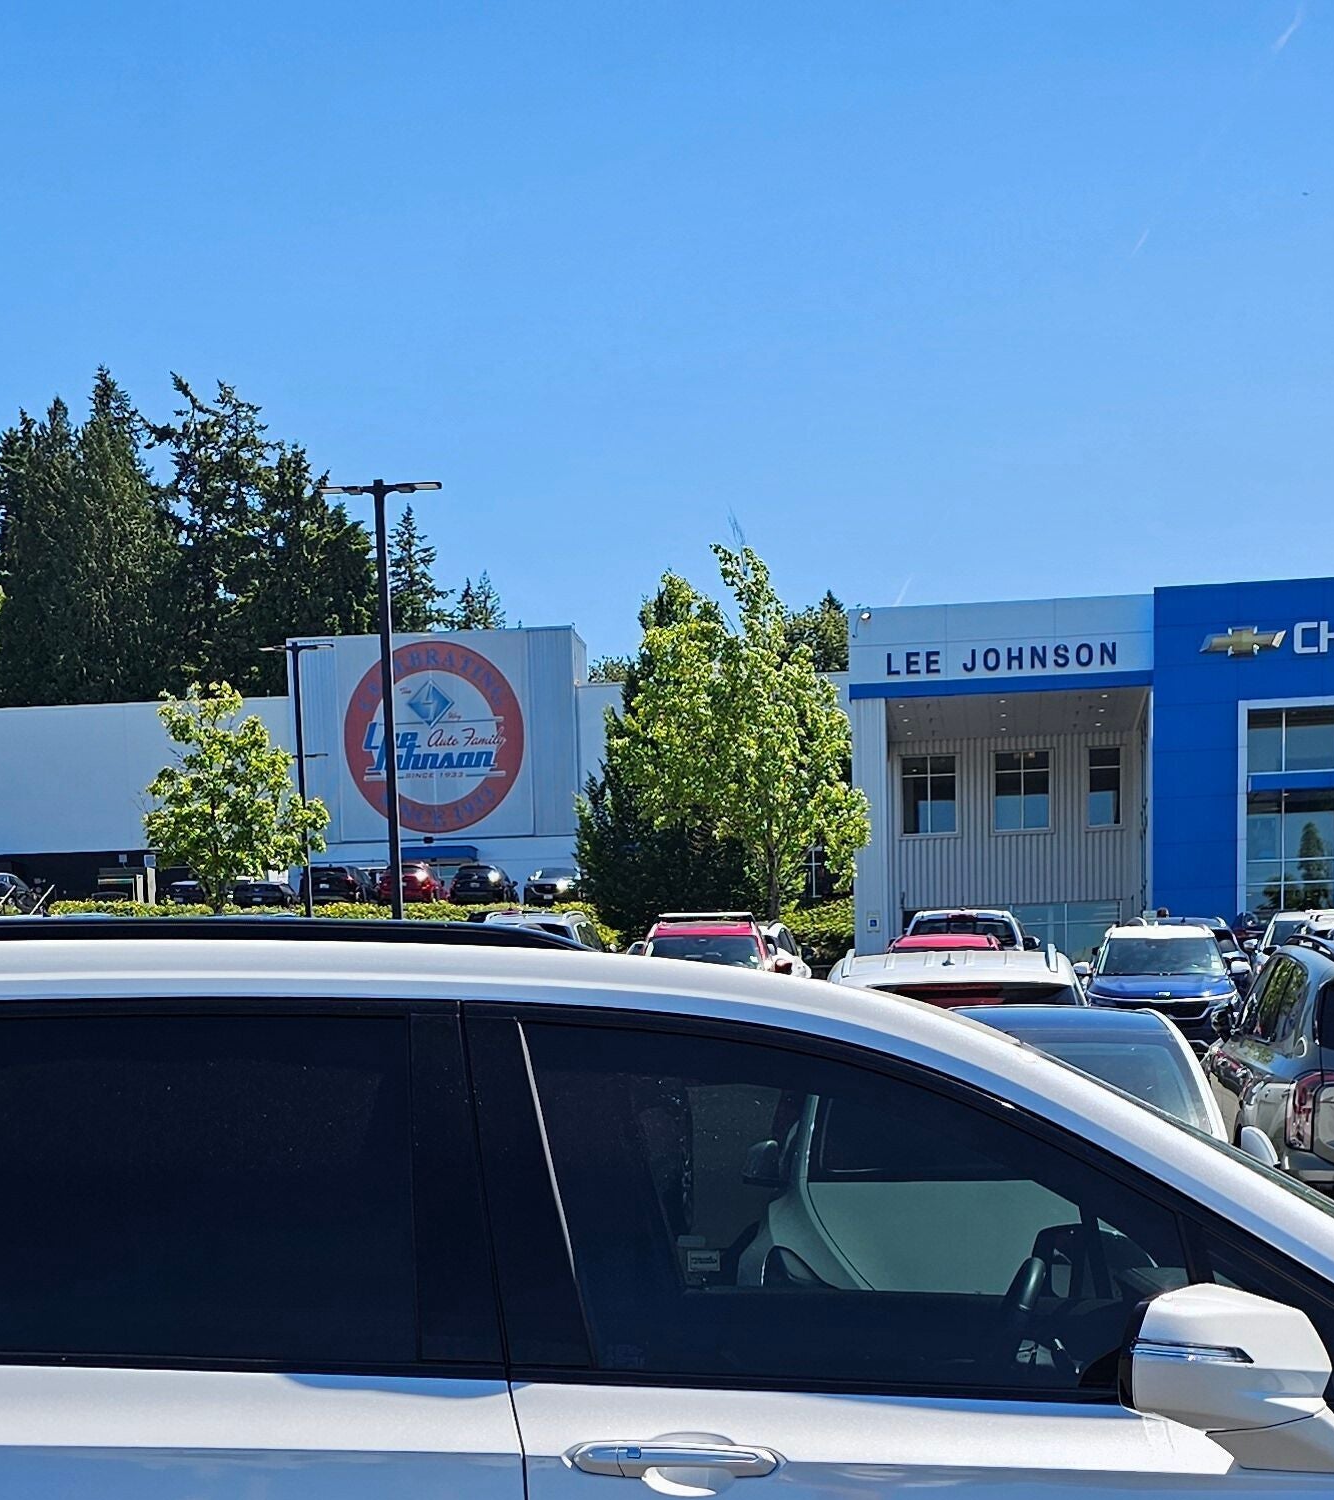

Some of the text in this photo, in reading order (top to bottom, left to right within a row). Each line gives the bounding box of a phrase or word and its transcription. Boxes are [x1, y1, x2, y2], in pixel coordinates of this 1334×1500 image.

[886, 641, 1118, 676] LEE JOHNSON
[363, 722, 507, 752] Le Auto Family
[366, 742, 498, 772] Jhnson
